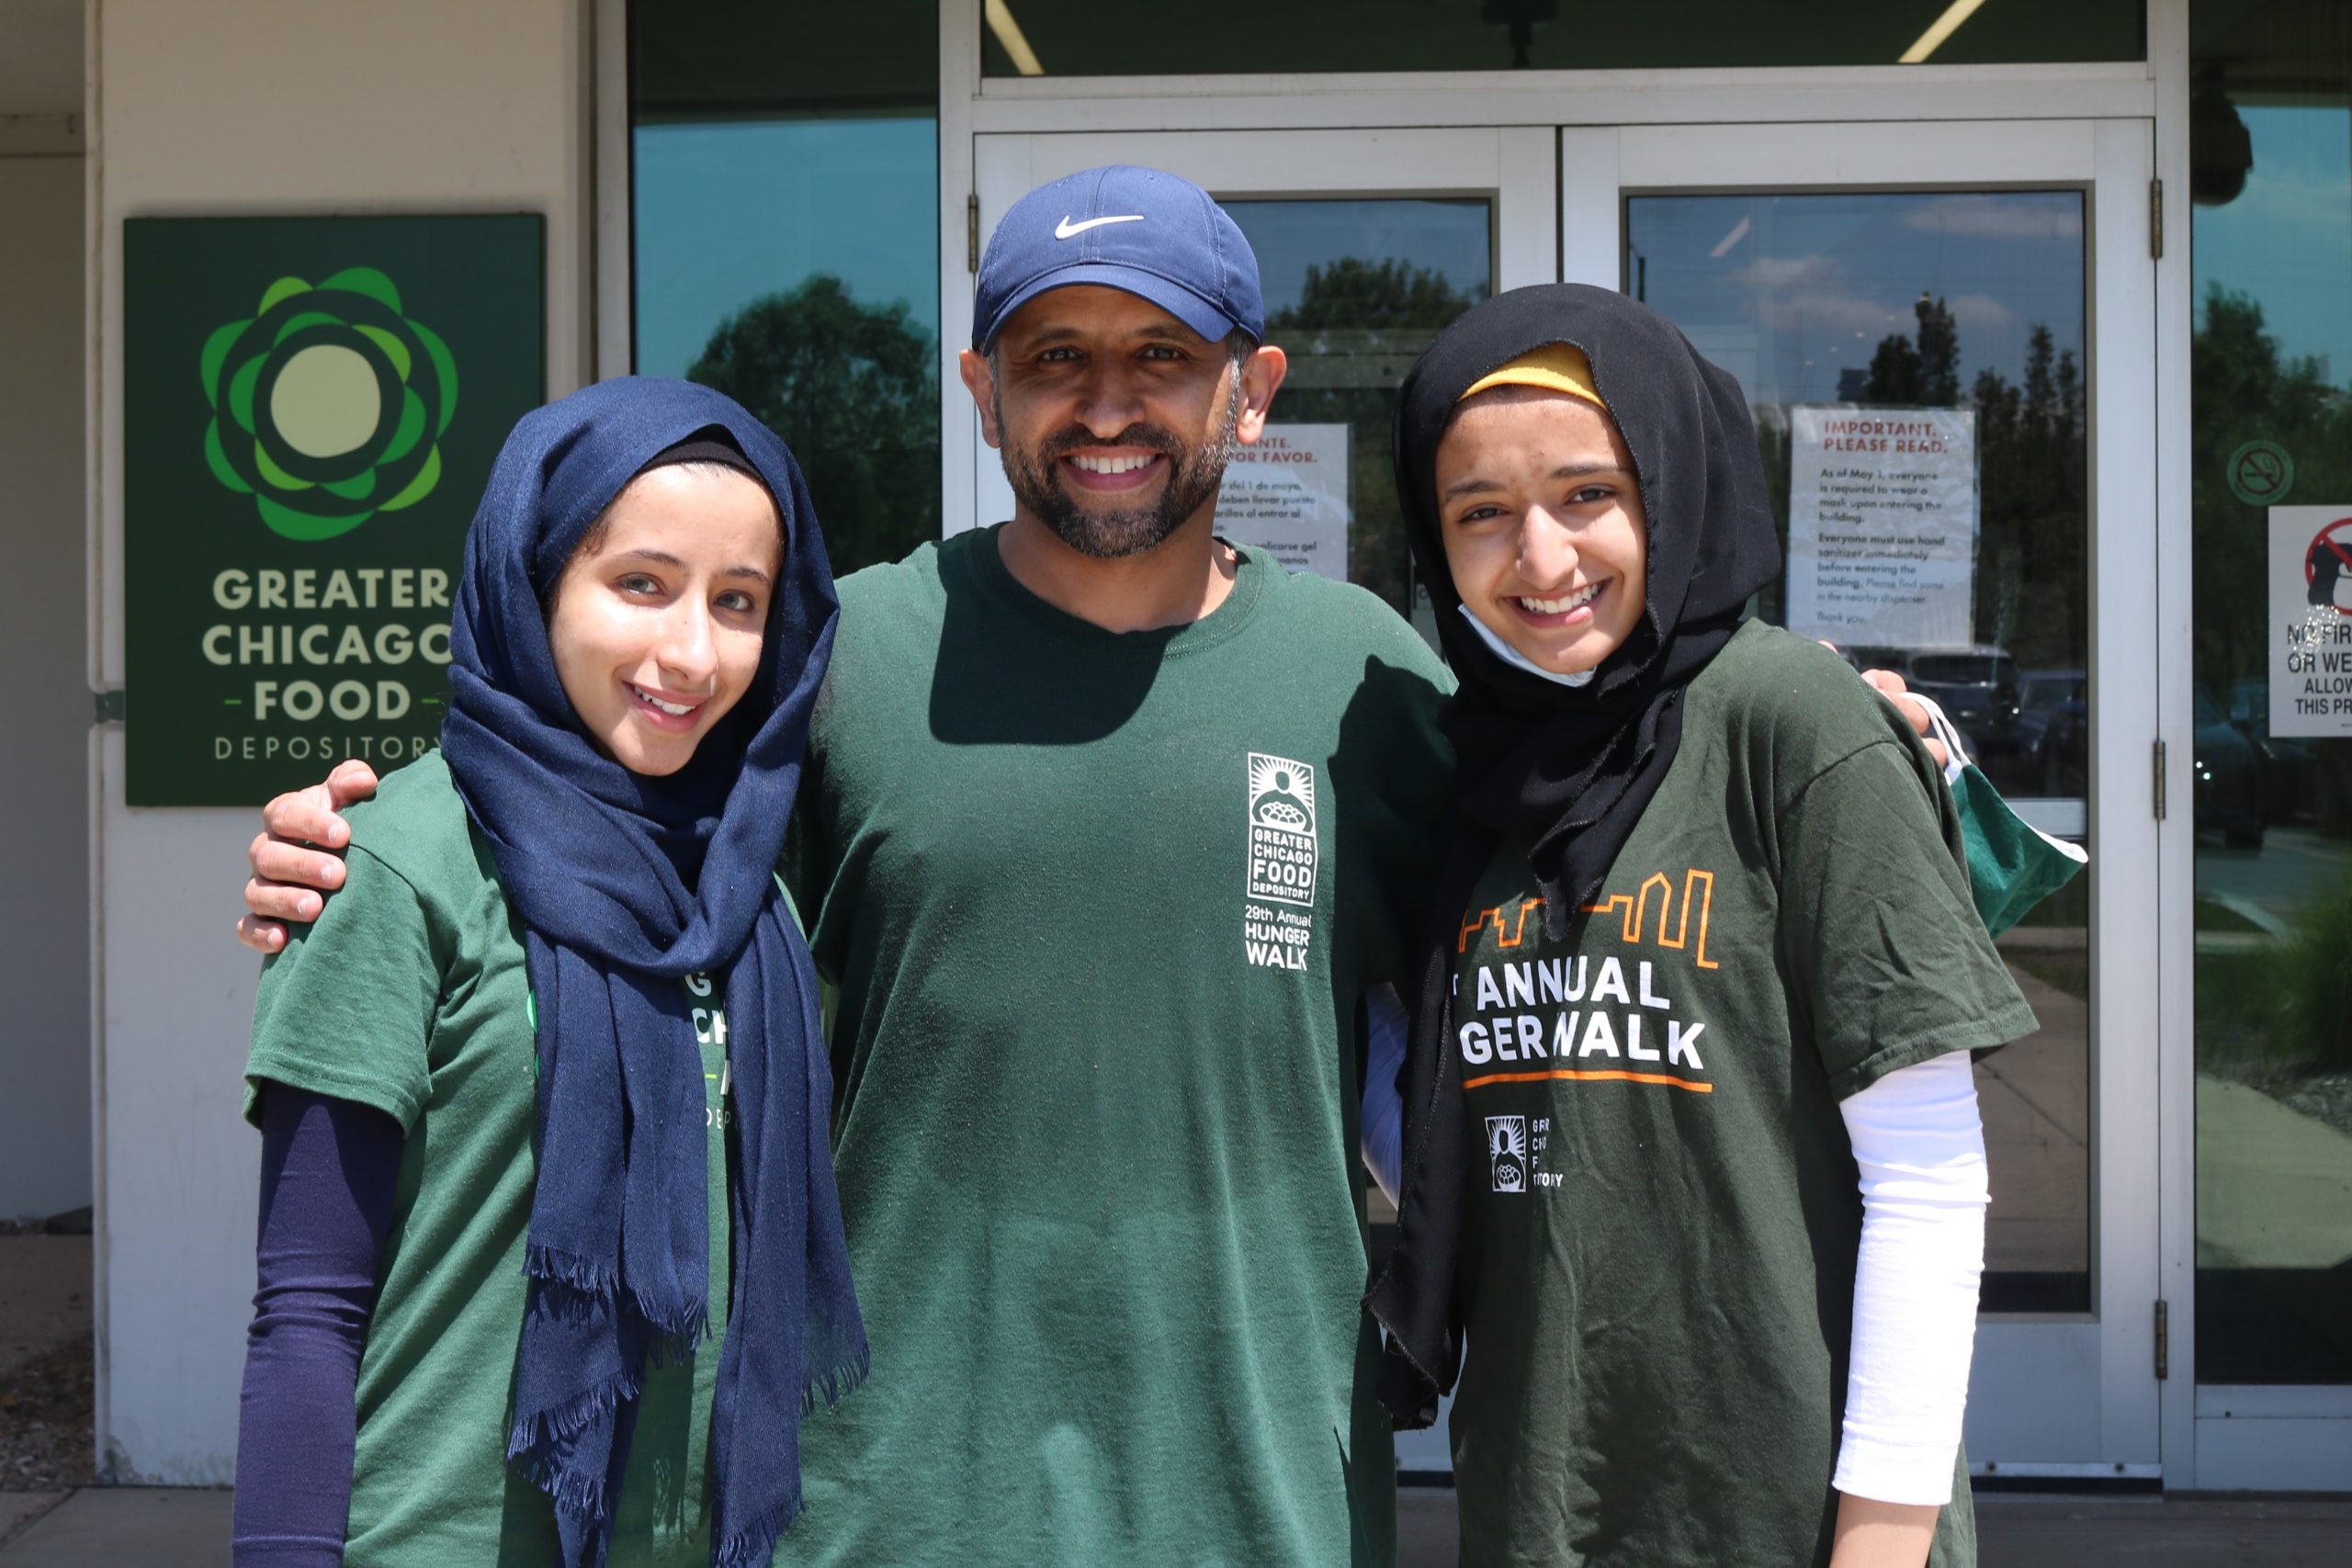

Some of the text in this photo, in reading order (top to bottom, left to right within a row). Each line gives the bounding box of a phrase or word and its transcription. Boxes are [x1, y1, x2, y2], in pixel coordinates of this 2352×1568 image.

[1825, 422, 1937, 437] IMPORTANT.
[1824, 438, 1948, 454] PLEASE READ.
[1262, 452, 1317, 464] FAVOR.
[1821, 468, 1834, 479] As
[1837, 468, 1847, 479] of
[1850, 470, 1873, 481] May
[1889, 471, 1938, 483] everyone
[1257, 481, 1270, 491] de
[1820, 484, 1828, 493] is
[1831, 486, 1874, 497] required
[1878, 487, 1888, 495] to
[1891, 487, 1917, 496] wear
[1252, 495, 1280, 504] llevar
[1820, 498, 1942, 513] mask upon entering the
[1247, 508, 1256, 518] al
[1259, 509, 1288, 518] entrar
[1291, 508, 1301, 518] al
[1819, 512, 1865, 525] building.
[1301, 540, 1317, 553] gel
[1819, 533, 1946, 547] Everyone must use hand
[1818, 547, 1929, 562] sanitizer immediately
[1817, 561, 1917, 576] before entering the
[212, 569, 450, 610] GREATER
[1899, 579, 1917, 589] find
[1827, 592, 1842, 603] the
[1844, 593, 1879, 604] nearby
[1817, 612, 1843, 622] Thank
[202, 624, 455, 666] CHICAGO
[2288, 652, 2315, 673] OR
[254, 680, 412, 721] FOOD
[2295, 699, 2329, 715] THIS
[214, 737, 441, 760] DEPOSITOR
[1254, 828, 1313, 852] GREATER
[1253, 843, 1313, 866] CHICAGO
[1253, 858, 1312, 888] FOOD
[1252, 881, 1310, 899] DEPOSITORY
[1245, 904, 1312, 928] 29th Annual
[1245, 921, 1310, 947] HUNGER
[1245, 940, 1308, 972] WALK
[1476, 955, 1670, 1011] ANNUAL
[1459, 1010, 1706, 1070] GER WALK
